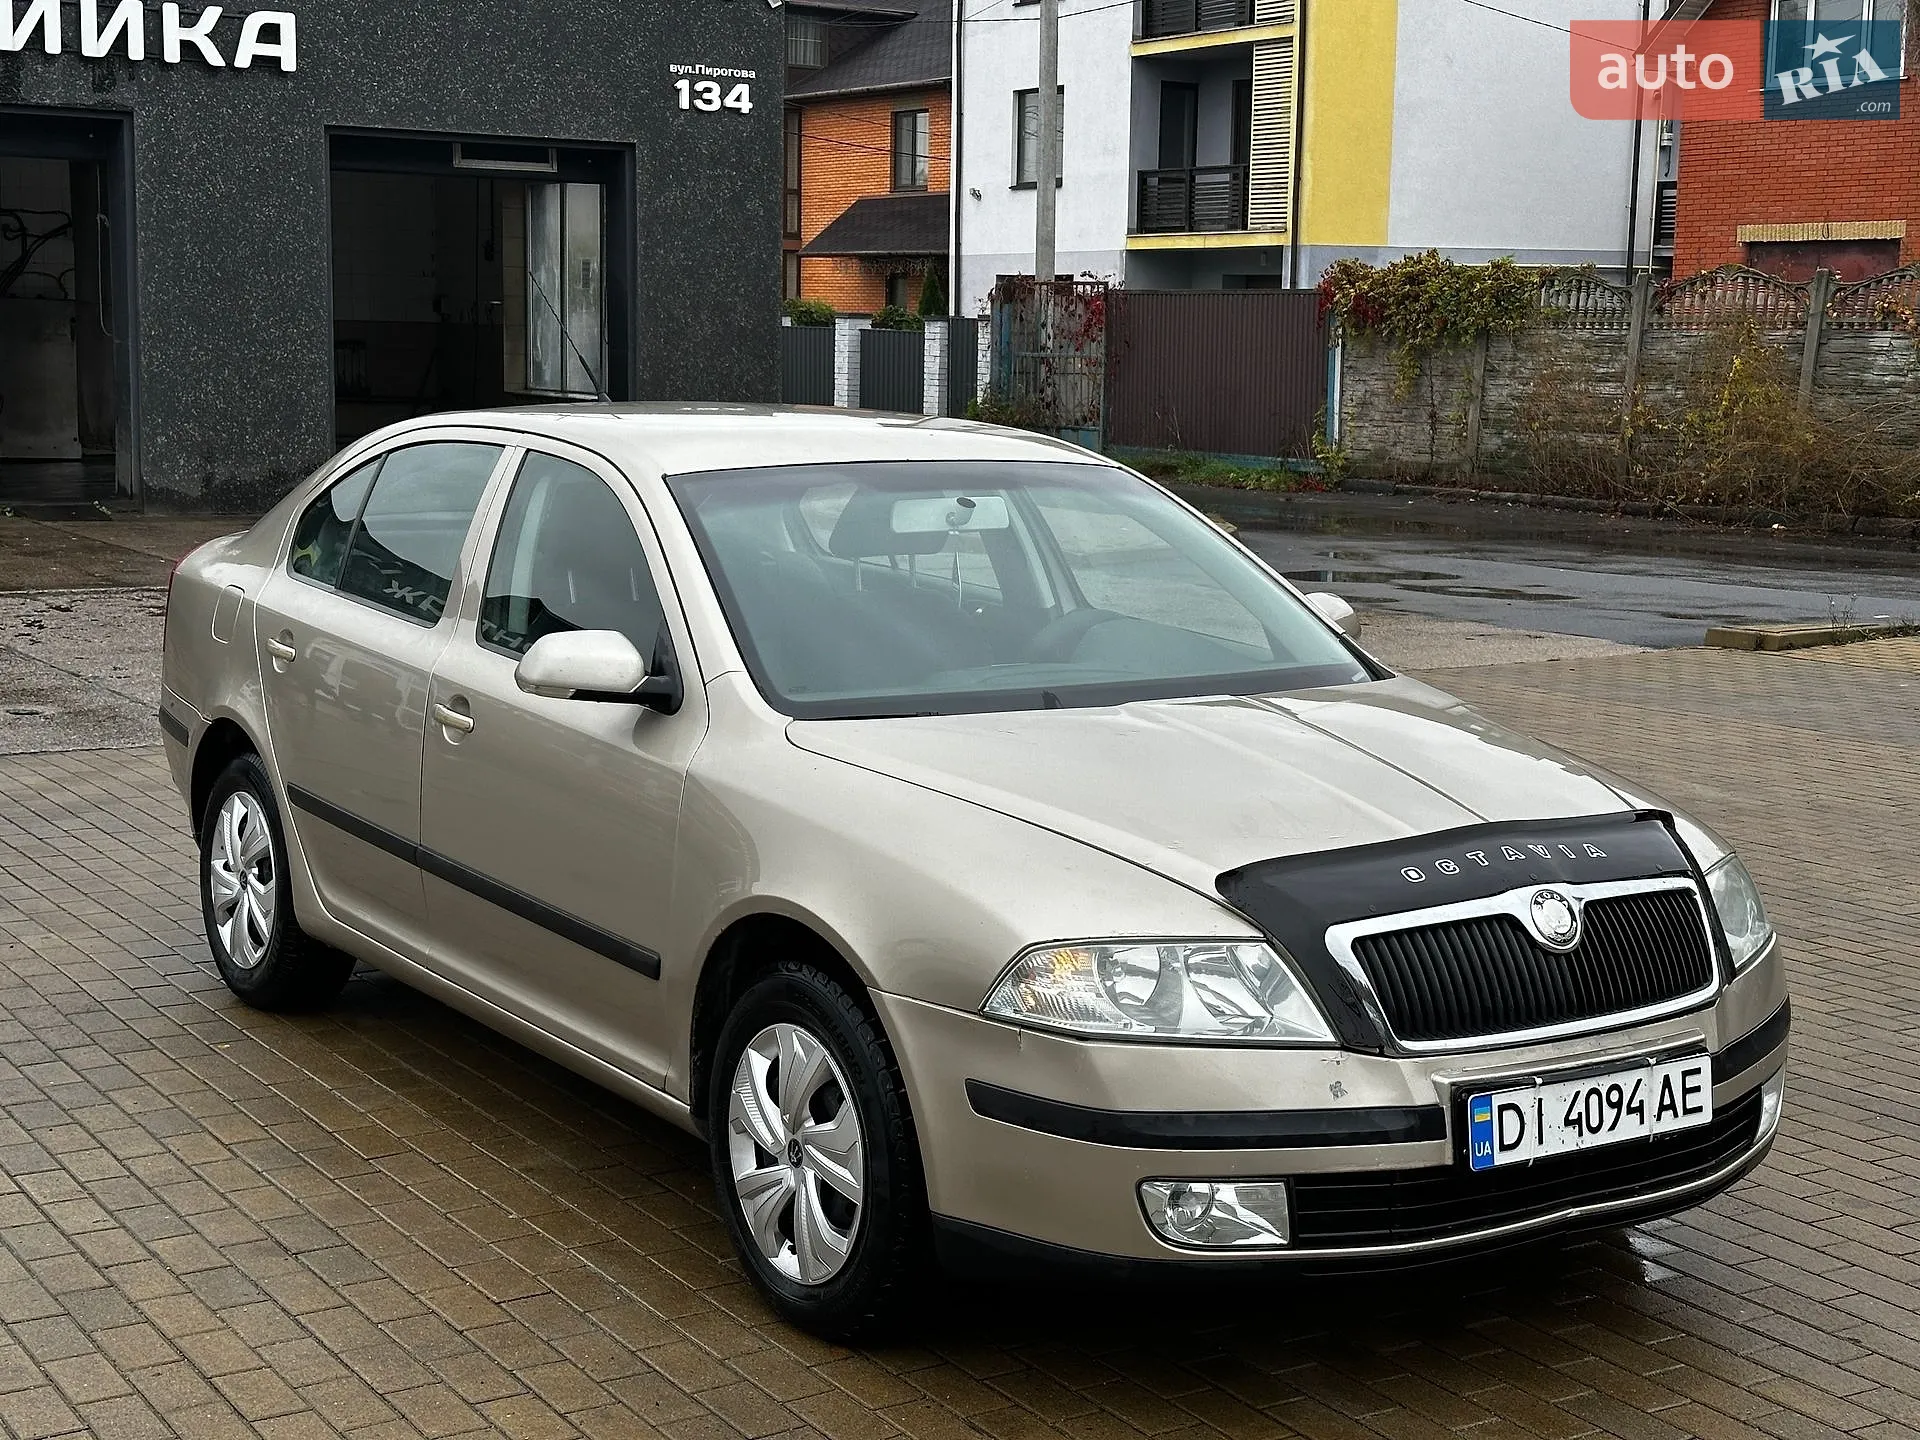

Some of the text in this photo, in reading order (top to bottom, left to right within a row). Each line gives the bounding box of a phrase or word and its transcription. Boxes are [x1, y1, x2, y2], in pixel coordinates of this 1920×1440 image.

[669, 63, 756, 79] вул.Пирогова
[674, 79, 753, 114] 134
[1400, 843, 1608, 883] OCTAVIA
[1497, 1066, 1704, 1153] DI 4094 AE
[1475, 1142, 1492, 1157] UA
